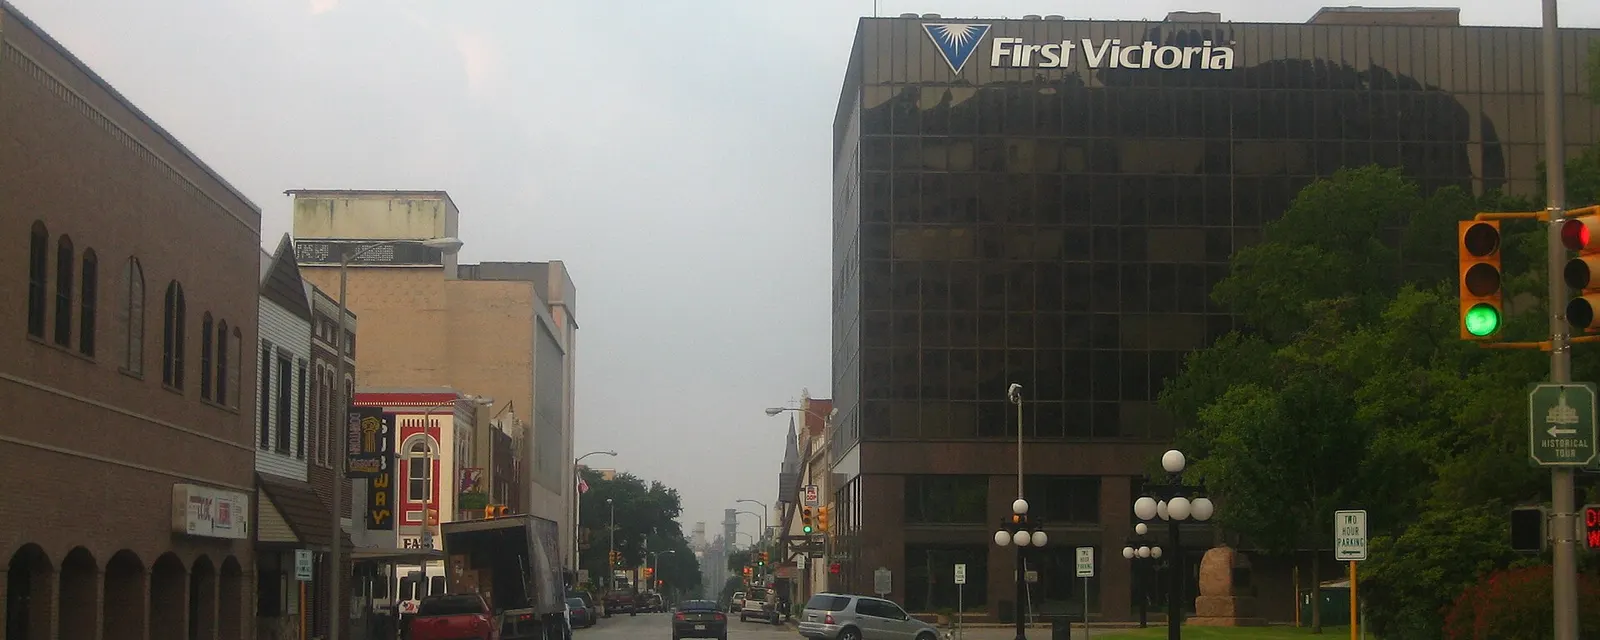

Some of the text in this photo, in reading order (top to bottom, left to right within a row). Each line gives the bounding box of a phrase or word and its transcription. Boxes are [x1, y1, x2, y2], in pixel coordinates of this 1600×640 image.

[990, 37, 1235, 70] First Victoria
[1541, 439, 1589, 448] HISTORICAL
[1555, 448, 1576, 458] TOUR
[1344, 515, 1357, 524] TWO
[1342, 526, 1359, 536] HOUR
[1337, 537, 1364, 547] PARKING
